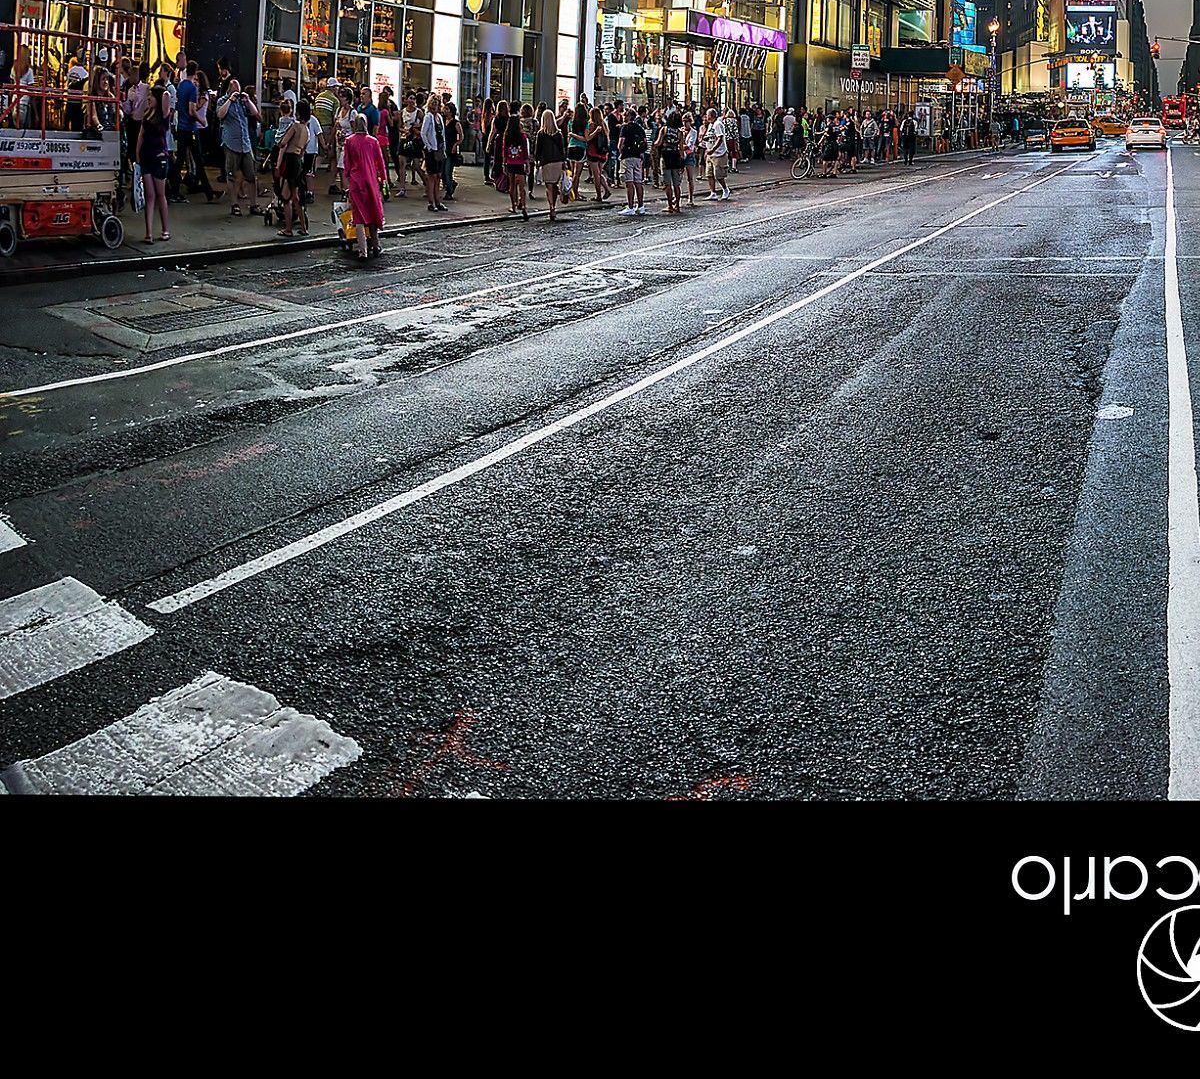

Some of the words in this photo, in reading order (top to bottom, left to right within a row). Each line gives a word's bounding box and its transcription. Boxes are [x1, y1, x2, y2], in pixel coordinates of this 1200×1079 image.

[714, 40, 757, 70] FOREVER
[756, 49, 770, 72] 21
[840, 77, 875, 94] VORNADO
[52, 213, 71, 224] JLG
